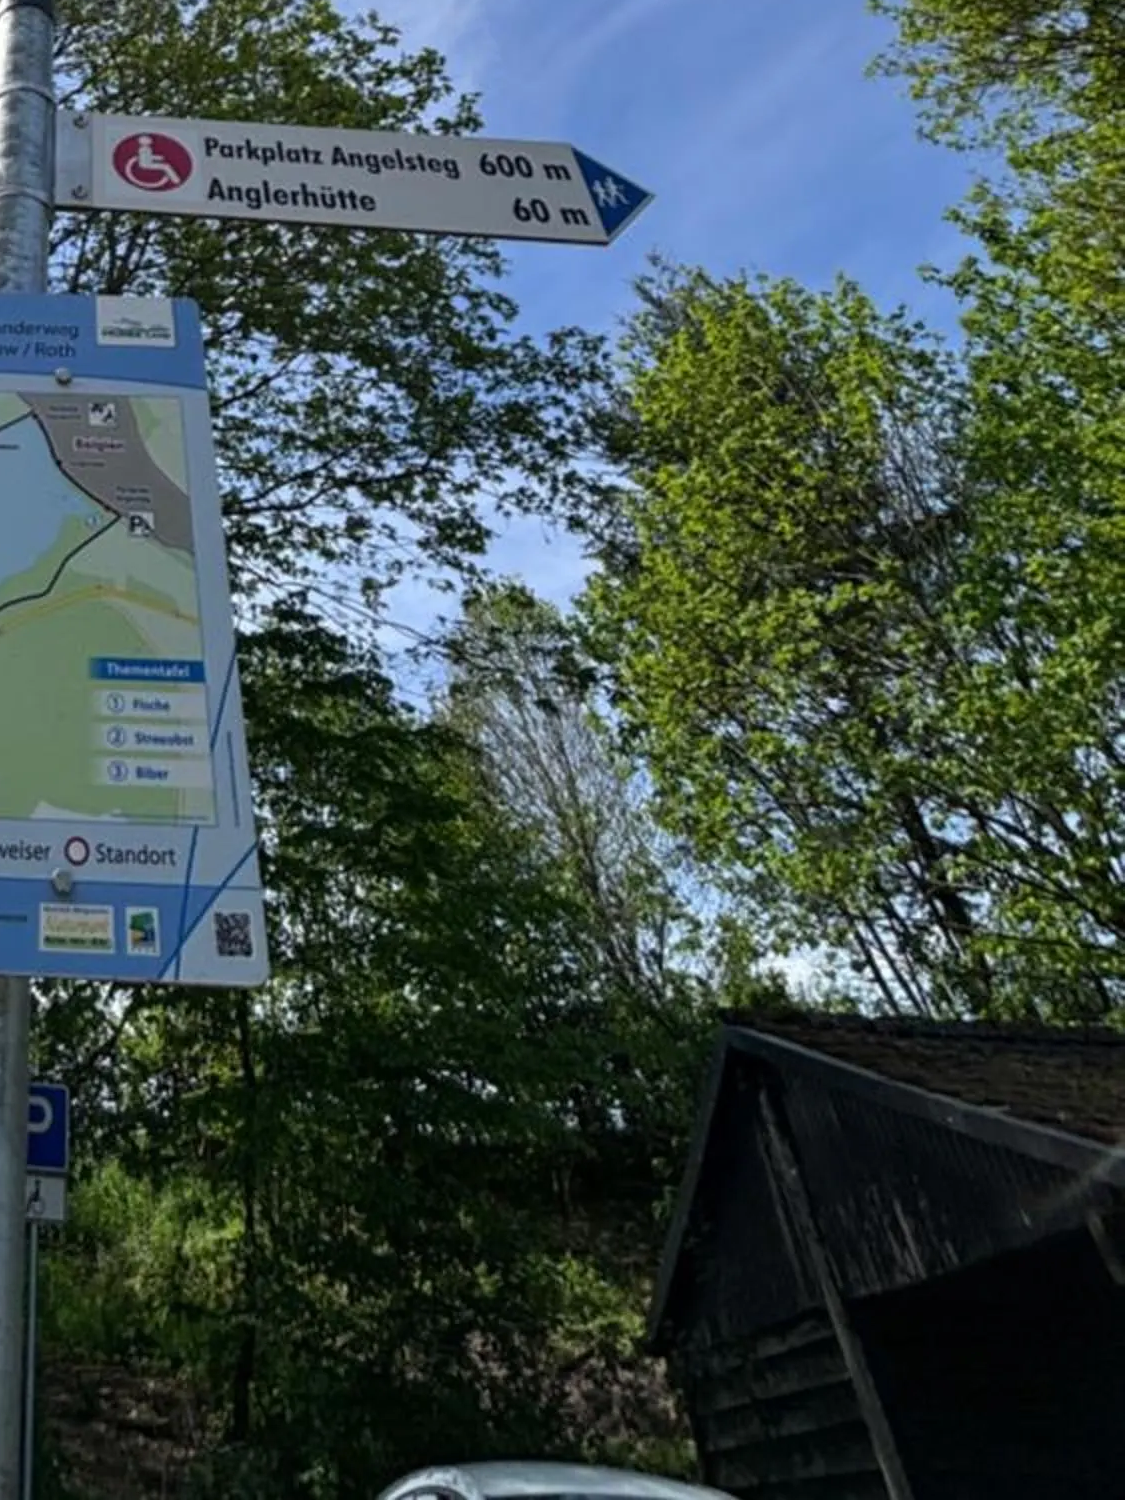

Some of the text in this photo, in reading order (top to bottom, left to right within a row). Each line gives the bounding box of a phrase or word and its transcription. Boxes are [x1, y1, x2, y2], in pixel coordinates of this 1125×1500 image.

[204, 137, 572, 182] Parkplatz Angelsteg 600 m
[207, 177, 590, 227] Anglerhütte 60 m
[34, 341, 76, 358] Roth
[106, 661, 190, 678] Thementafel
[135, 765, 170, 781] Biber
[94, 843, 177, 867] Standort
